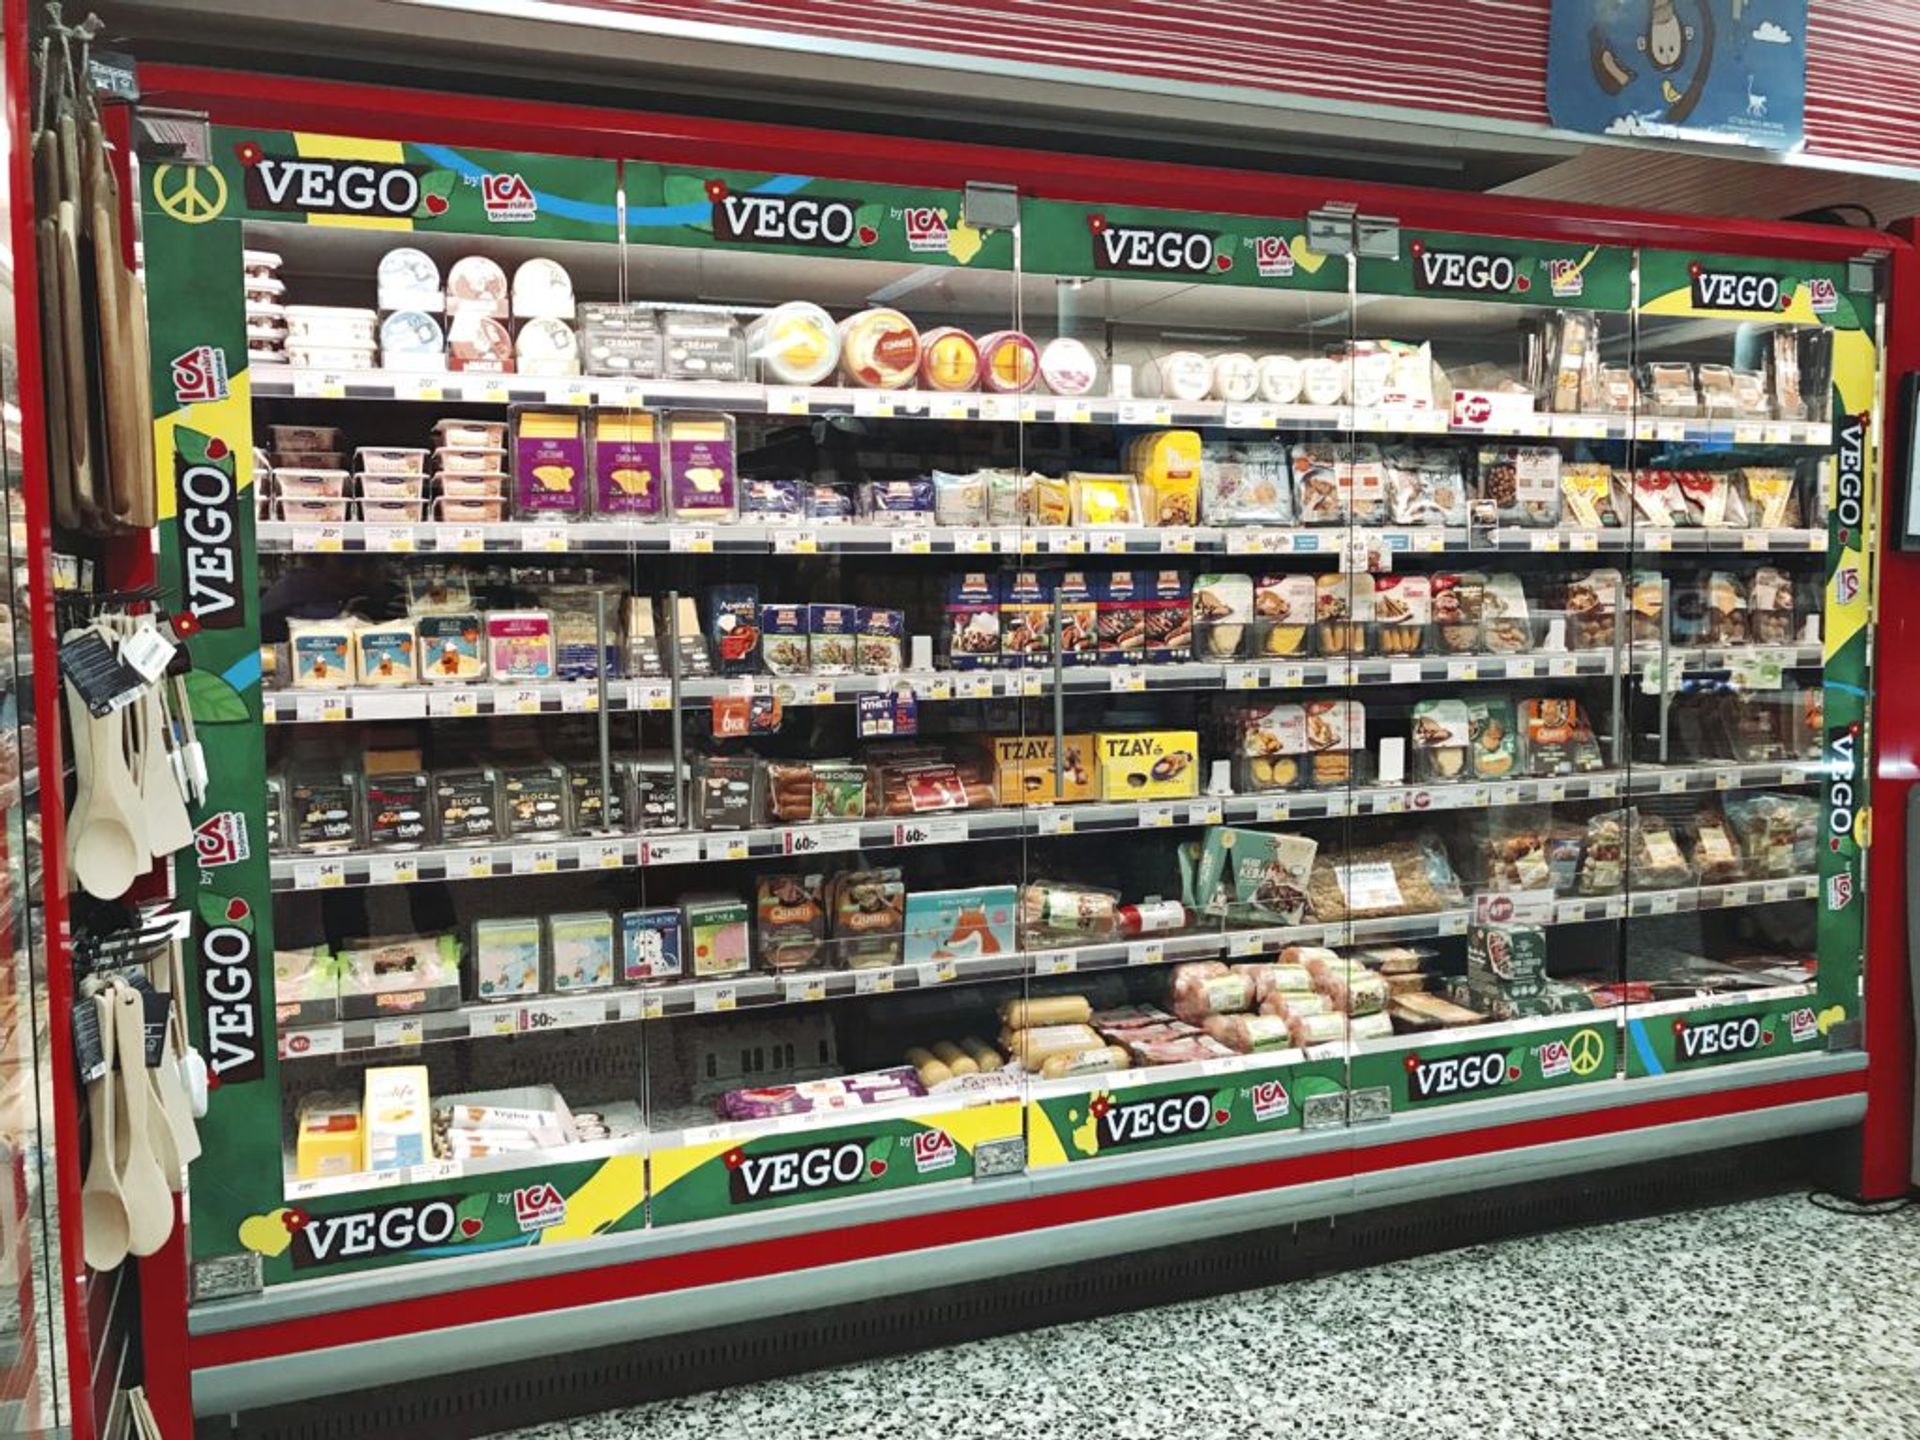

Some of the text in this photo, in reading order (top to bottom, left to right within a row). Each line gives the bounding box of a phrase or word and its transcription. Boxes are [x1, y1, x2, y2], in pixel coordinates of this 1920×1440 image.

[256, 160, 533, 213] VEGO by ICA
[723, 196, 945, 243] VEGO by ICA
[1102, 229, 1212, 270] VEGO
[1257, 237, 1291, 258] ICA
[1421, 253, 1513, 290] VEGO
[1699, 274, 1835, 308] VEGO ICA
[682, 341, 719, 350] CREAMY
[174, 349, 205, 400] ICA
[1839, 424, 1861, 600] VEGO ICA
[183, 466, 235, 618] VEGO
[999, 741, 1050, 760] TZAY
[1106, 739, 1154, 757] TZAY
[452, 795, 482, 806] BLOCK
[520, 791, 549, 801] BLOCK
[905, 828, 928, 843] 60:-
[1830, 735, 1854, 906] VEGO ICA
[795, 837, 819, 851] 60:-
[770, 907, 810, 923] Quorn
[197, 814, 255, 1074] VEGO by ICA
[531, 1013, 557, 1028] 50:-
[1683, 1018, 1759, 1057] VEGO
[1792, 1009, 1814, 1027] ICA
[1417, 1054, 1505, 1094] VEGO
[1541, 1041, 1569, 1063] ICA
[1106, 1095, 1210, 1141] VEGO
[1254, 1082, 1286, 1104] ICA
[740, 1144, 864, 1195] VEGO
[915, 1131, 953, 1156] ICA
[303, 1185, 563, 1259] VEGO by ICA
